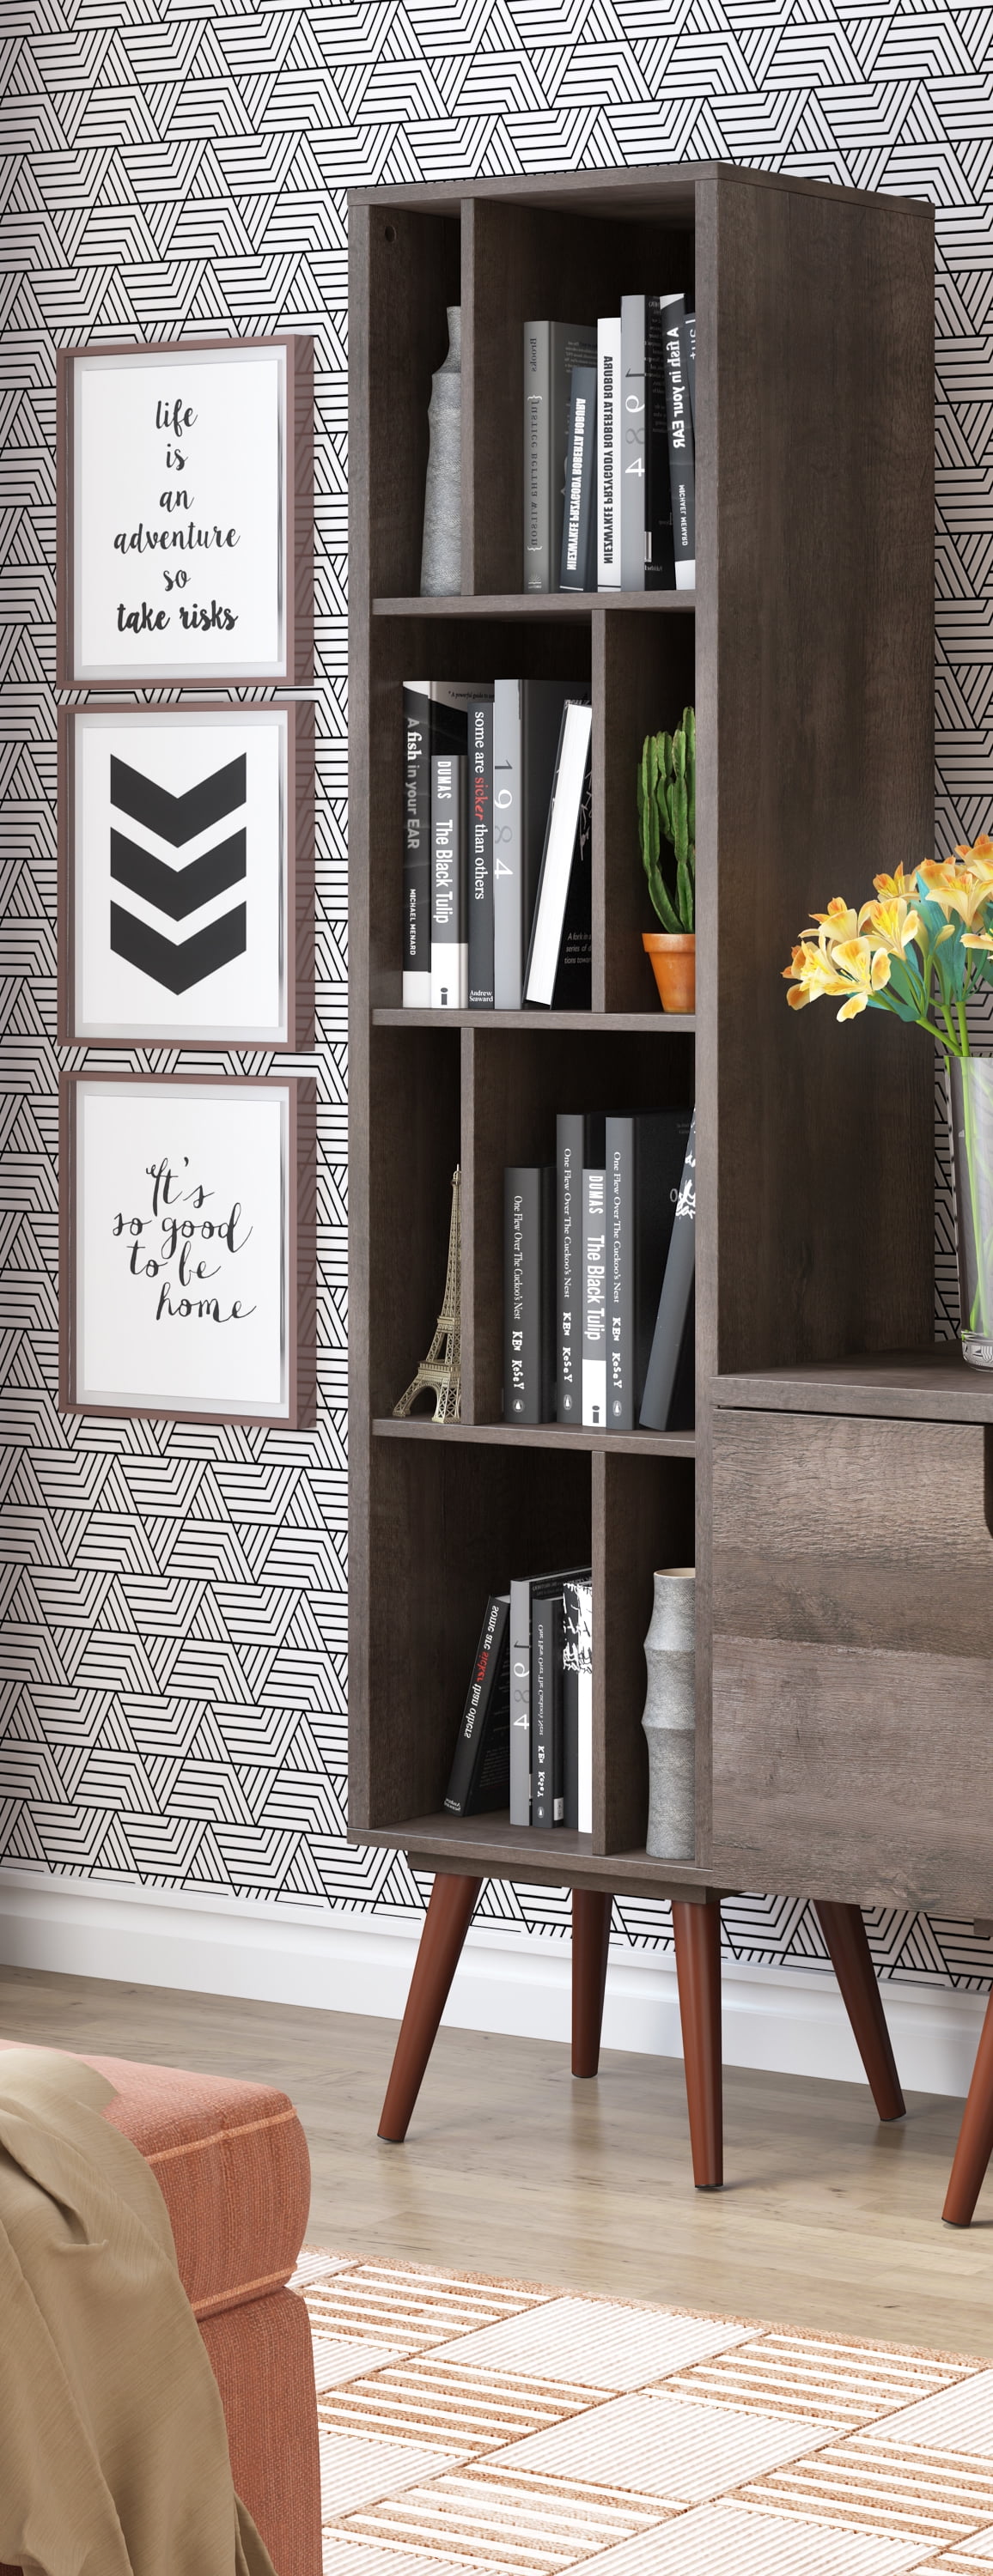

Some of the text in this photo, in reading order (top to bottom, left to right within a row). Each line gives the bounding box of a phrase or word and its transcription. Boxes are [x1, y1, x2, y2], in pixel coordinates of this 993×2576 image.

[155, 398, 198, 437] life
[166, 443, 188, 471] is
[159, 490, 194, 512] an
[113, 521, 241, 554] adventure
[162, 569, 191, 592] so
[117, 599, 238, 634] take risks
[405, 717, 423, 849] A fish in your EAR
[474, 711, 488, 900] some are sicker than others
[433, 761, 453, 924] DUMAS The Black Tulip
[145, 1157, 215, 1217] It's
[113, 1202, 253, 1259] so good
[126, 1239, 222, 1286] to be
[514, 1195, 522, 1319] One Flew Over The Cuckoo's Nest
[584, 1176, 605, 1340] DUMAS The Black Tulip
[156, 1282, 257, 1322] home
